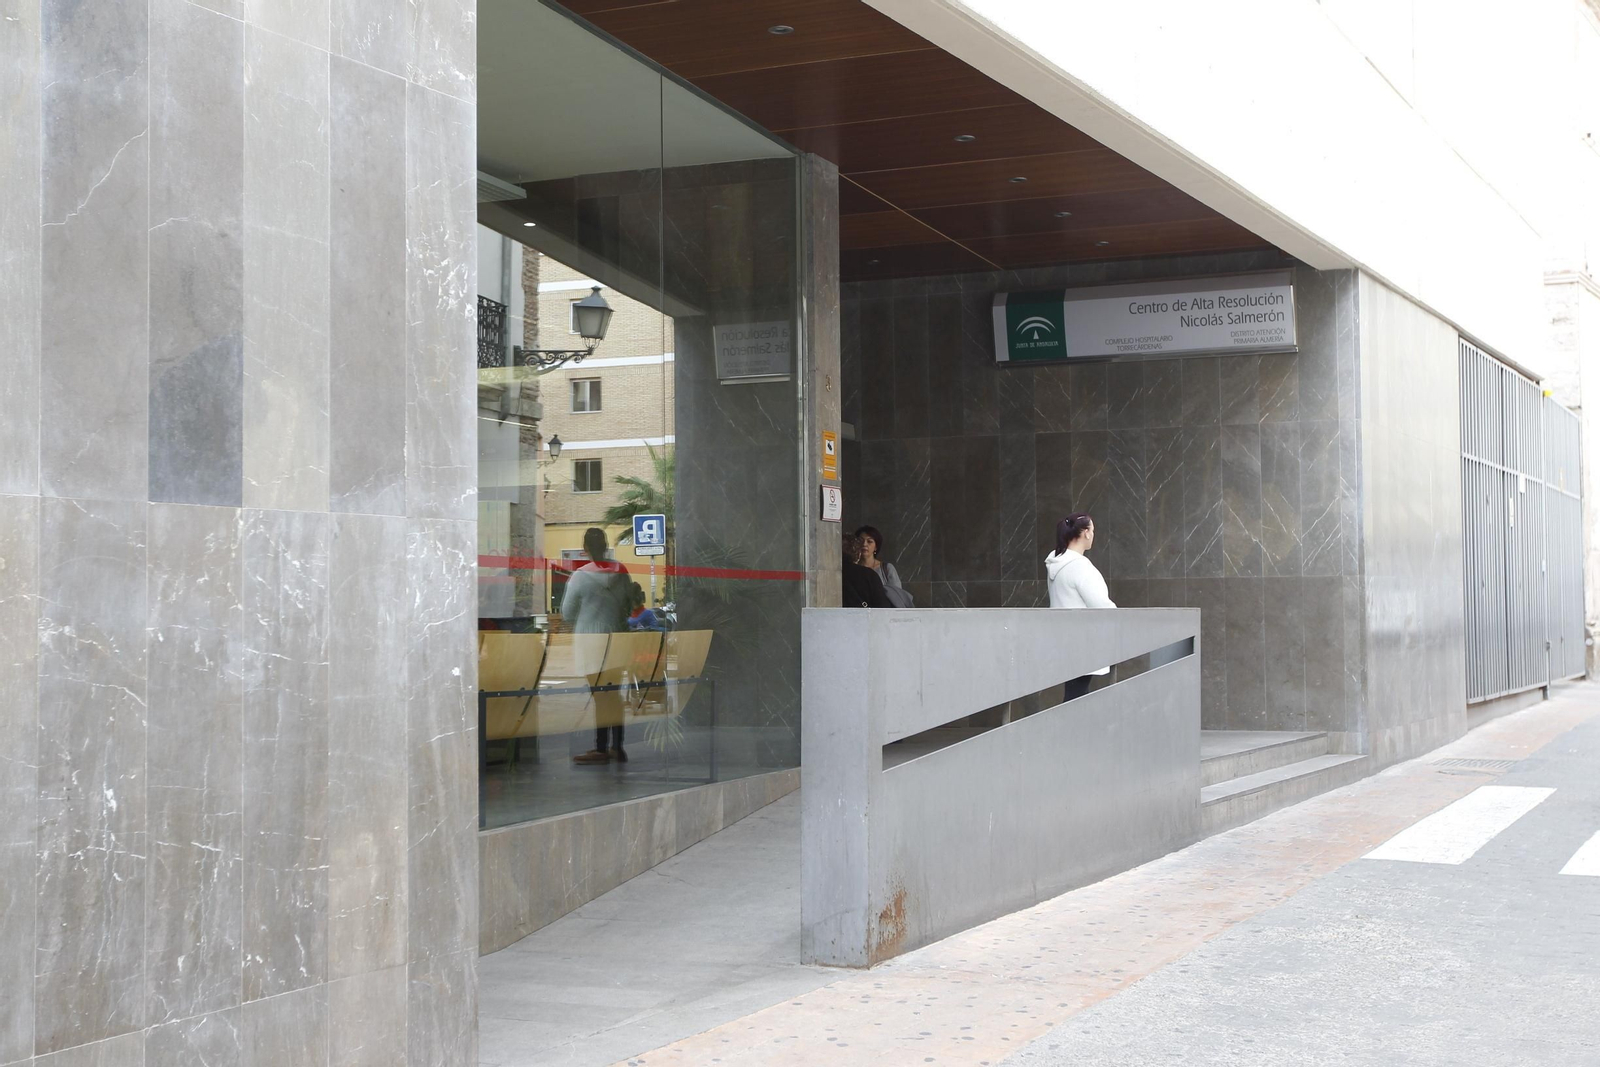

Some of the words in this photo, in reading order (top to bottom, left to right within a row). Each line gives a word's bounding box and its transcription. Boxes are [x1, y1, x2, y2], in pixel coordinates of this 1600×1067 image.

[1128, 302, 1168, 315] Centro
[1172, 300, 1187, 312] de
[1191, 298, 1214, 311] Alta
[1218, 293, 1284, 309] Resolución
[1180, 313, 1223, 328] Nicolás
[1228, 309, 1285, 325] Salmerón
[1230, 329, 1255, 338] DISTRITO
[1255, 327, 1286, 336] ATENCIÓN
[1105, 337, 1134, 346] COMPLEJO
[1135, 335, 1173, 343] HOSPITALARIO
[1233, 337, 1259, 345] PRIMARIA
